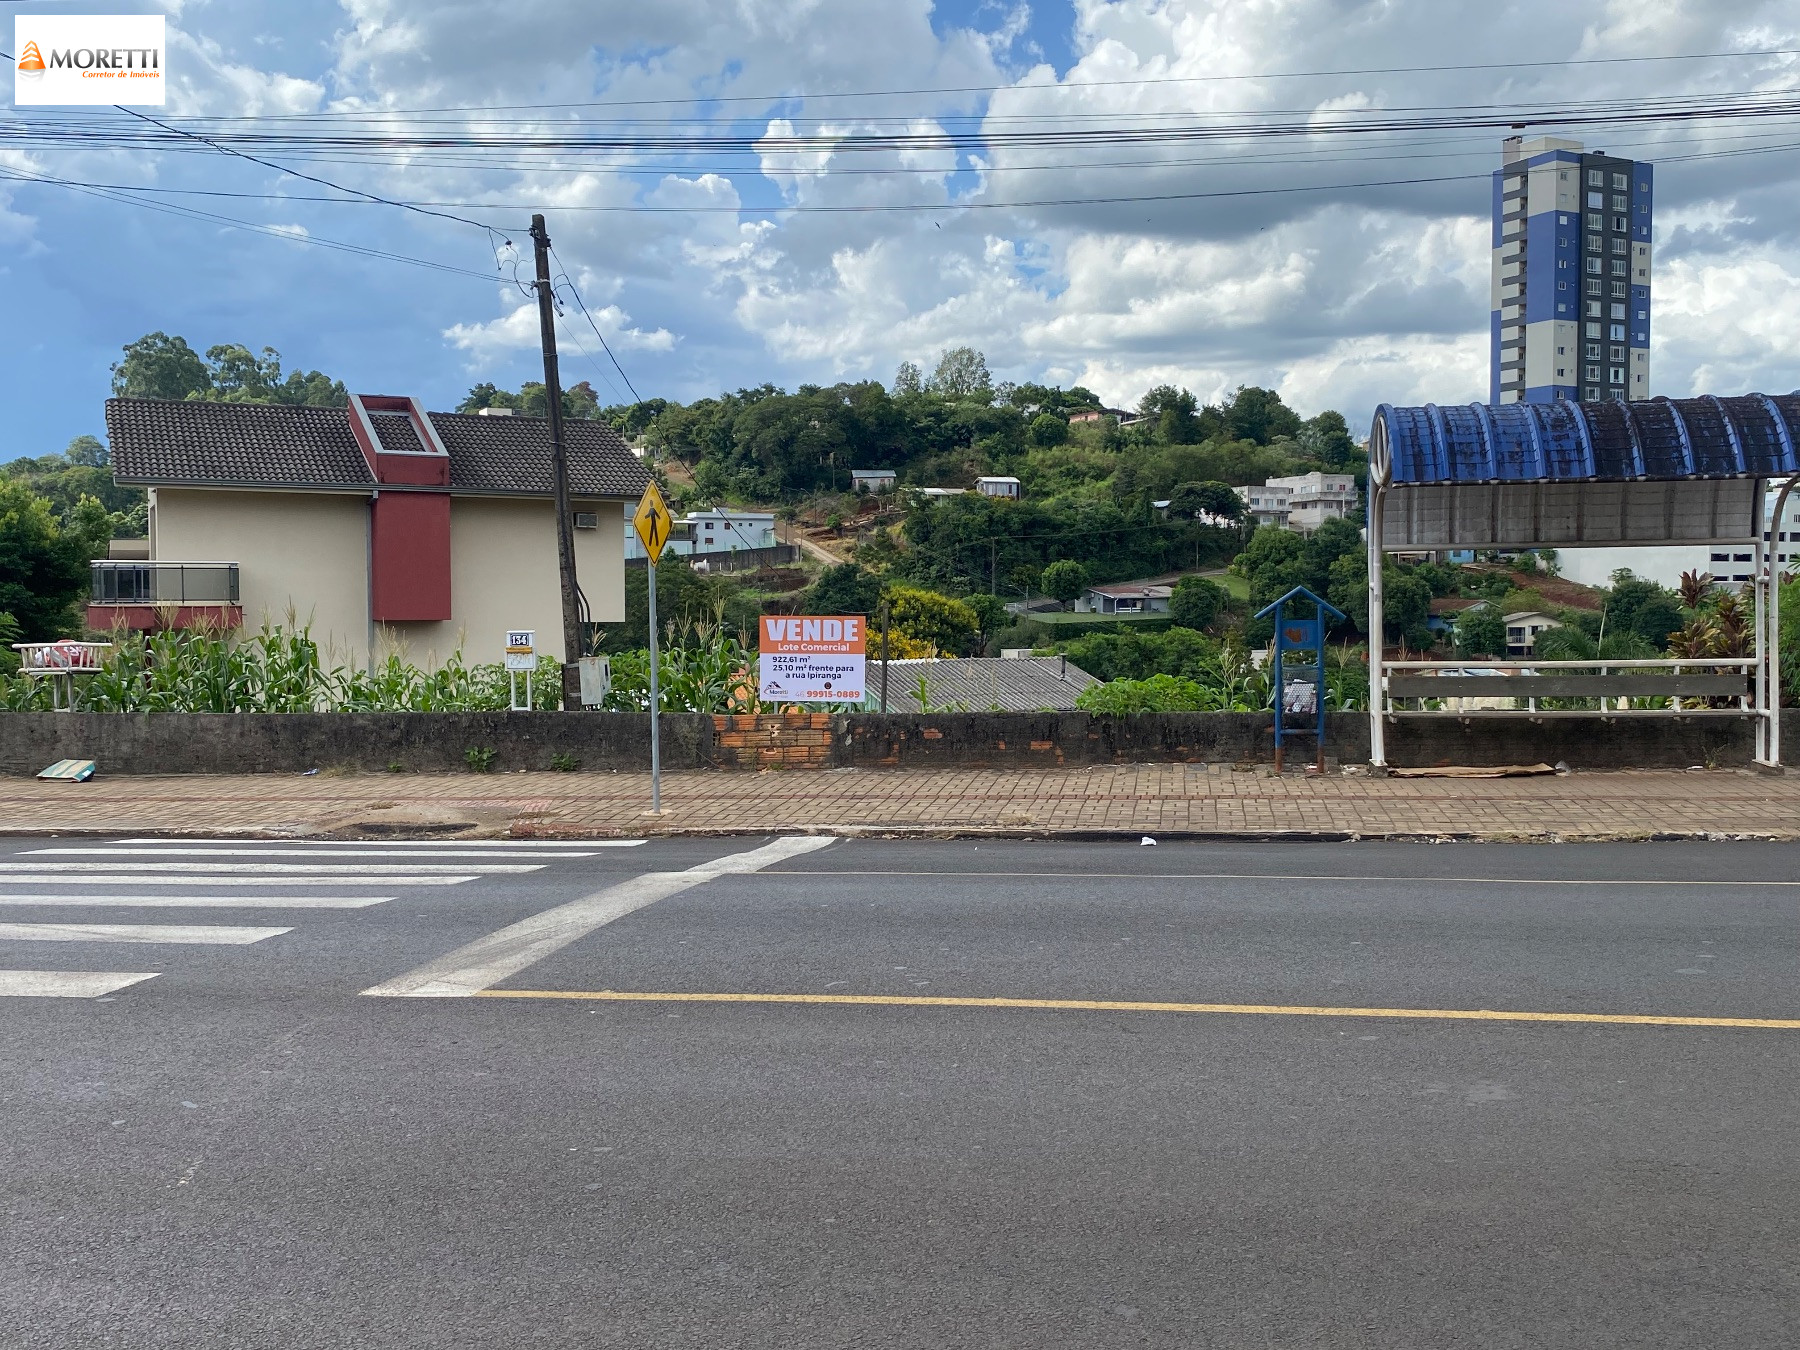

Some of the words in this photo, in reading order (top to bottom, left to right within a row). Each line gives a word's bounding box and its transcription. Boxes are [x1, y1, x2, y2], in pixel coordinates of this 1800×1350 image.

[766, 619, 859, 642] VENDE
[512, 635, 527, 645] 134
[778, 643, 800, 651] Lote
[801, 643, 849, 651] Comercial
[772, 656, 797, 664] 922,61
[773, 664, 794, 672] 25,10
[808, 664, 834, 672] frente
[807, 672, 842, 680] Ipiranga
[806, 690, 860, 698] 99915-0889
